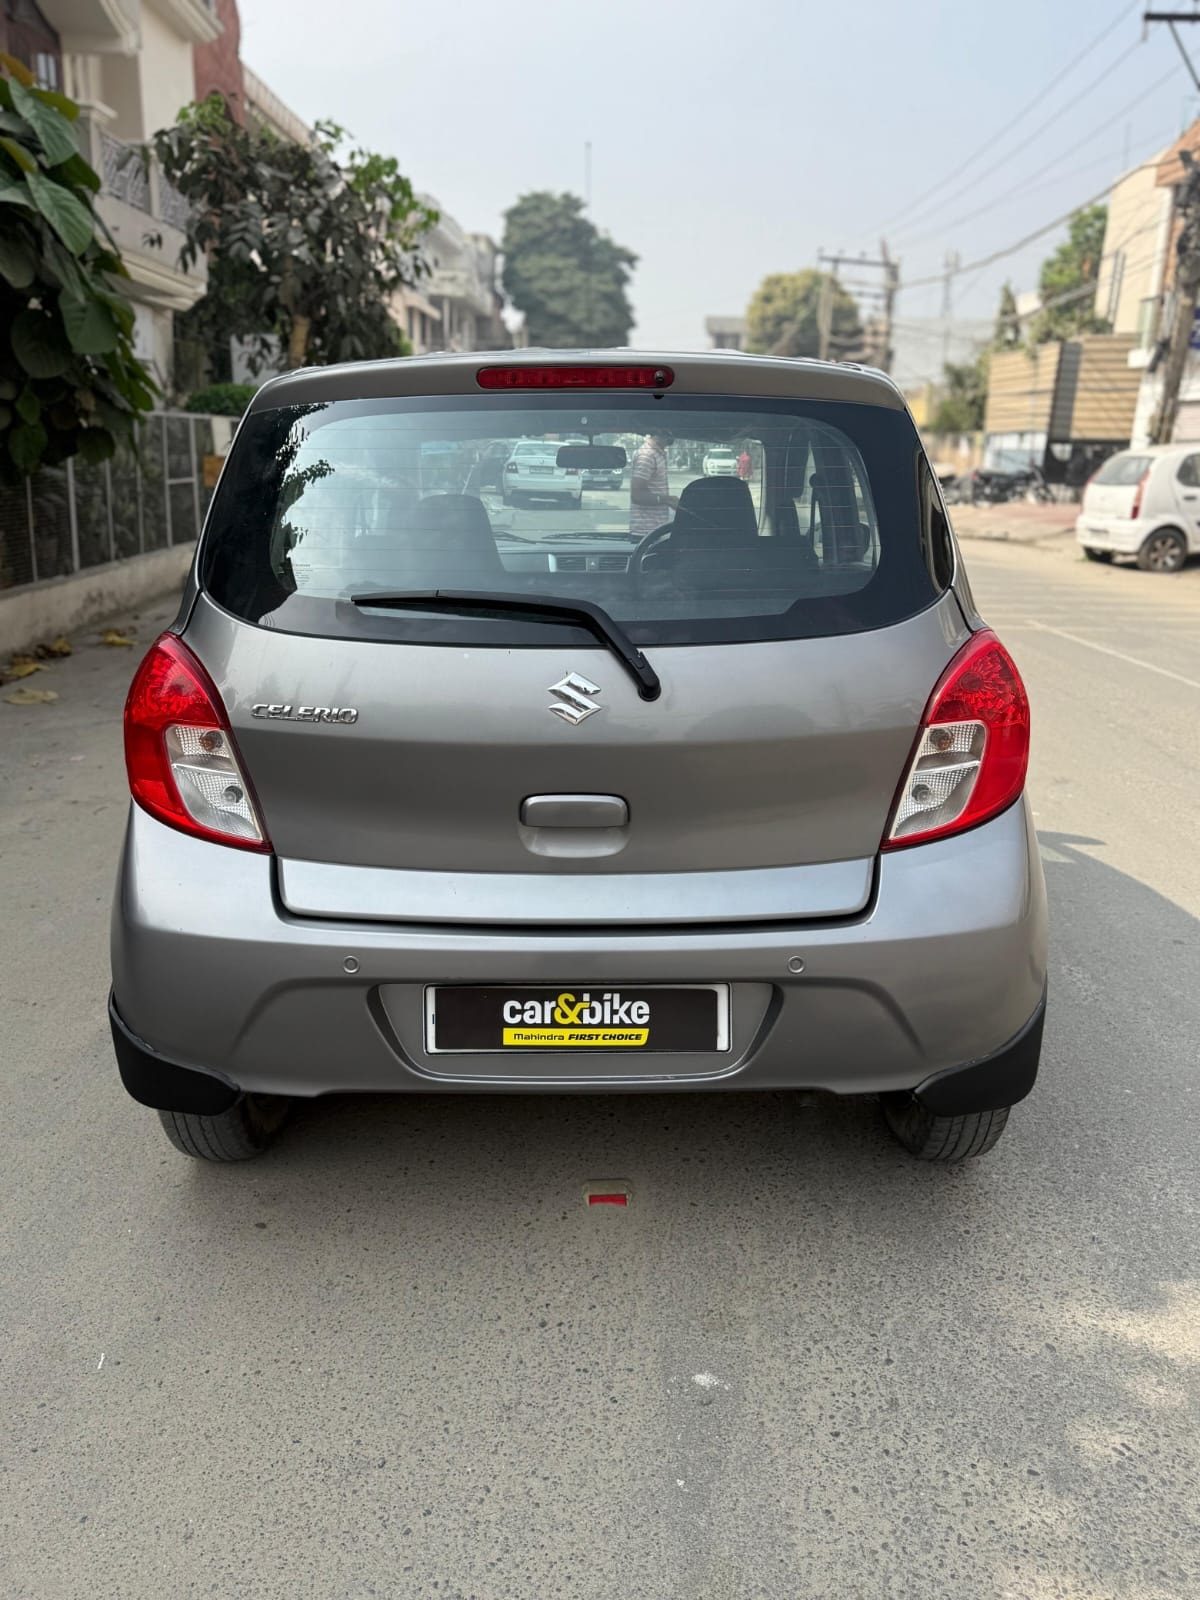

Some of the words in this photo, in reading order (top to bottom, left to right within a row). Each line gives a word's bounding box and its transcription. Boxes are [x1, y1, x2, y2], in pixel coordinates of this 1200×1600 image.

[251, 703, 358, 724] CELERIO
[503, 993, 650, 1024] car&bike
[514, 1033, 565, 1041] Mahindra
[568, 1033, 601, 1041] FIRST
[602, 1033, 643, 1041] CHOICE
